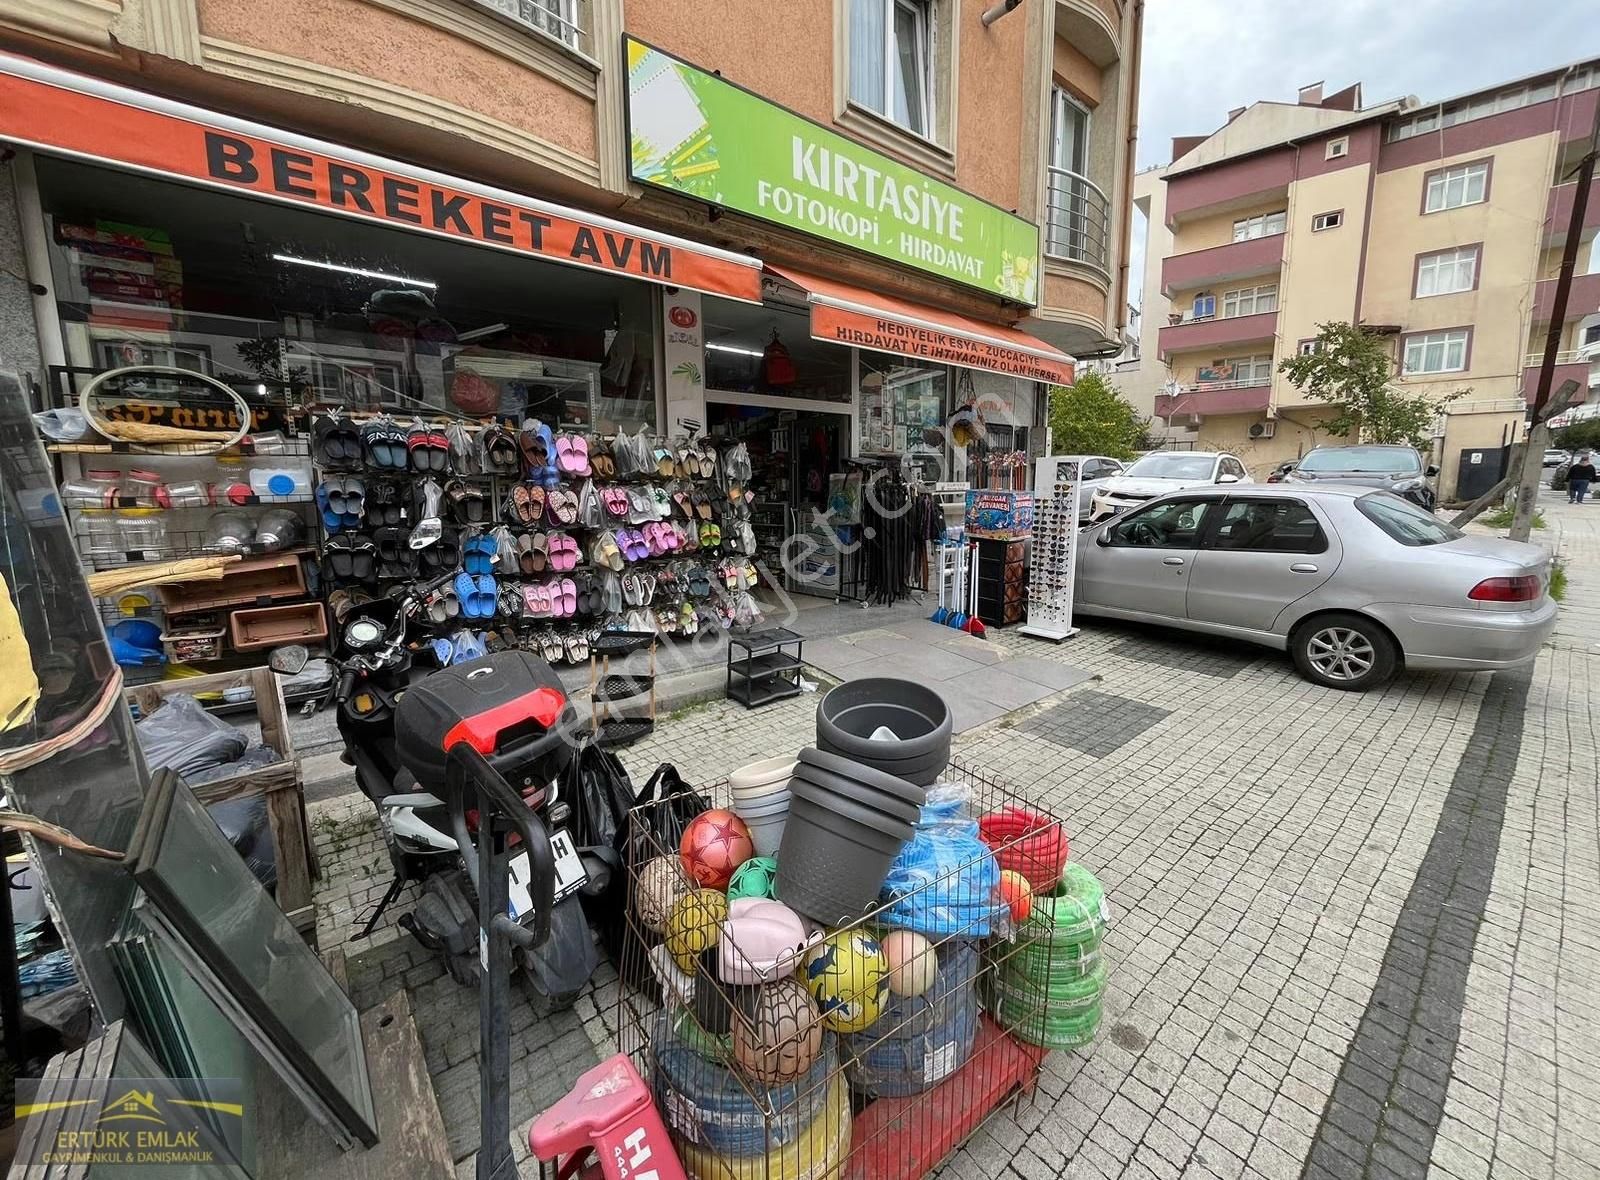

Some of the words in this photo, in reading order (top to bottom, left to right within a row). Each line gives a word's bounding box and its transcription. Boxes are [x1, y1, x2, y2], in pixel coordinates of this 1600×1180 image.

[204, 132, 551, 250] BEREKET
[570, 226, 671, 278] AVM
[758, 179, 879, 245] FOTOKOPİ
[900, 232, 984, 280] HIRDAVAT
[792, 135, 964, 242] KIRTASİYE
[836, 326, 908, 352] HIRDAVAT
[911, 342, 928, 355] VE
[1000, 361, 1026, 375] OLAN
